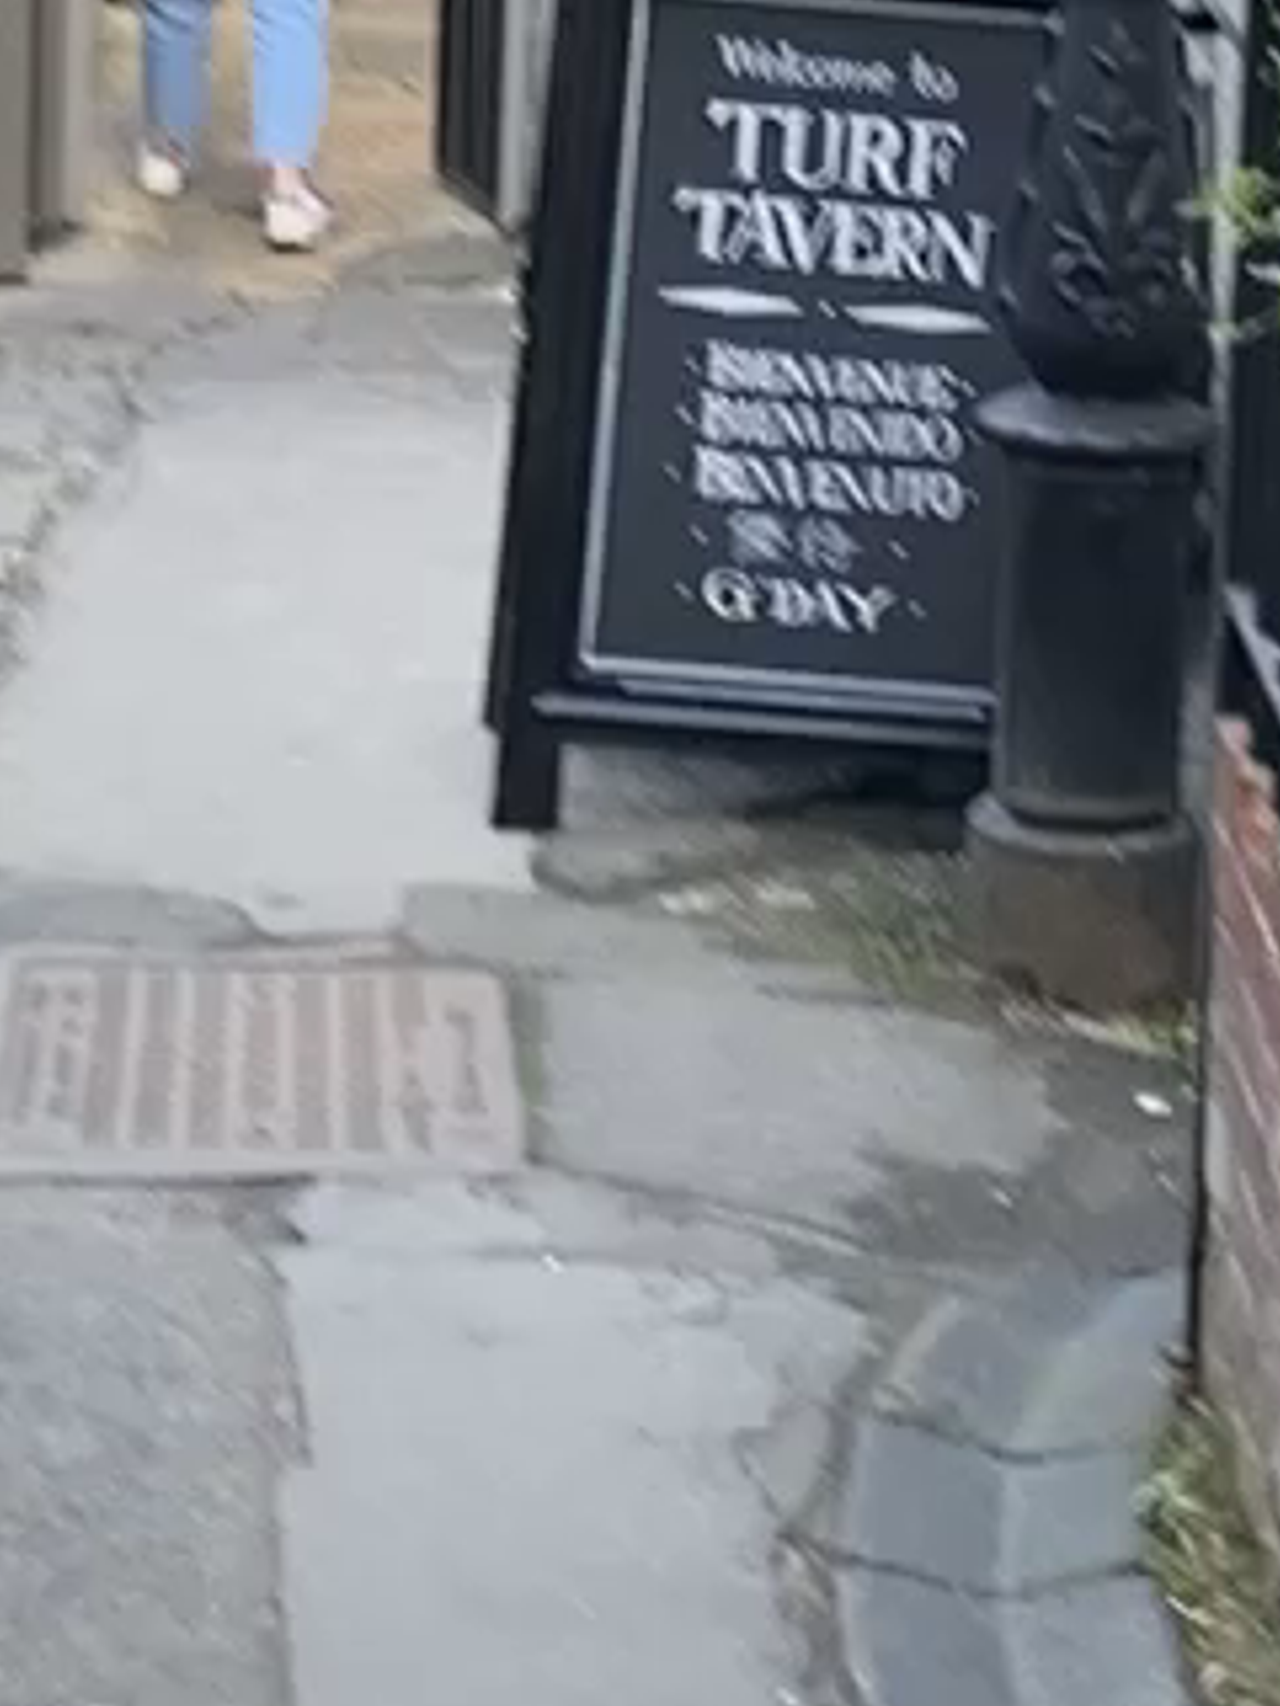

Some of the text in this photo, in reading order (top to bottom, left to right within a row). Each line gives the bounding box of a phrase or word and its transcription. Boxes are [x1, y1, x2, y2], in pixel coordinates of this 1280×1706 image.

[716, 34, 961, 104] Welcome to
[706, 98, 969, 202] TURF
[673, 187, 996, 288] TAVERN
